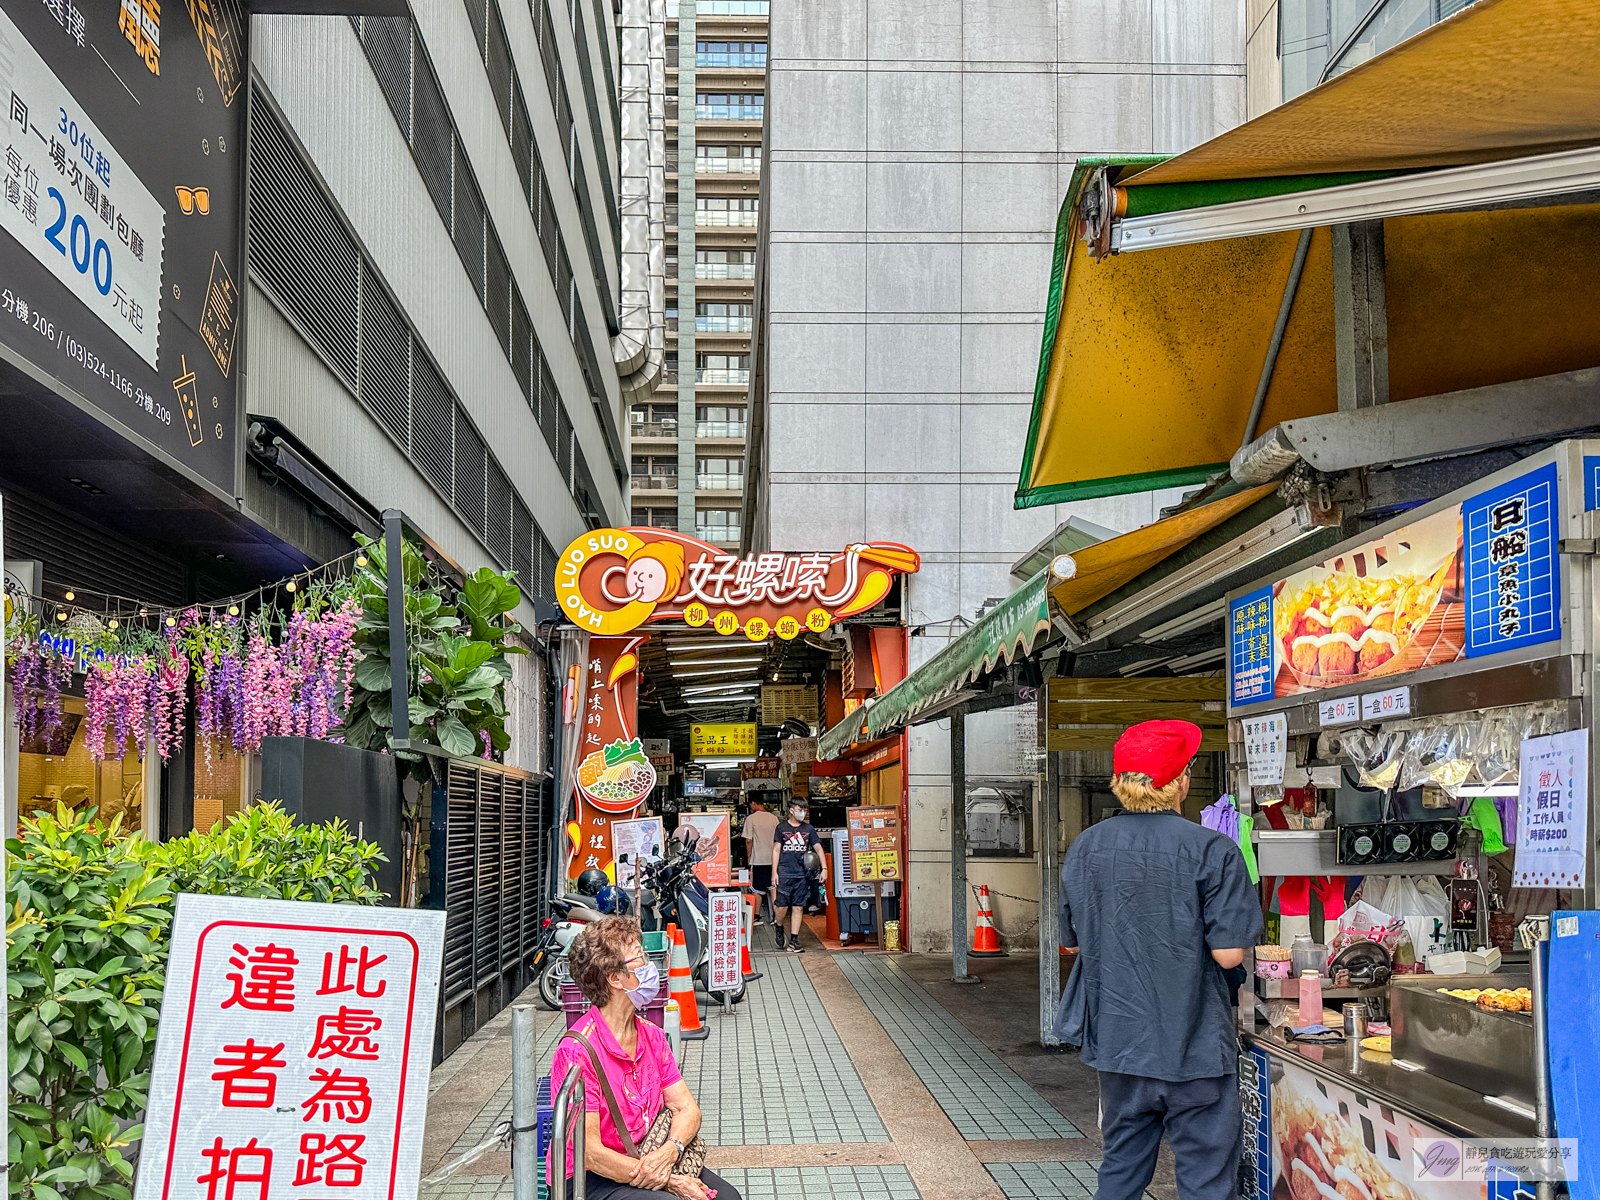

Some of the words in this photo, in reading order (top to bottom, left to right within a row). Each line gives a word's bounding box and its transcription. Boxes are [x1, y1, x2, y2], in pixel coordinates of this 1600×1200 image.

[6, 144, 39, 198] 每位
[58, 107, 110, 188] 30位起
[4, 173, 38, 226] 優惠
[10, 90, 144, 262] 同一場次團劃包廳
[1, 288, 29, 325] 分機
[32, 311, 55, 341] 206
[65, 335, 133, 398] (03)524-1166
[135, 388, 153, 415] 分機
[155, 403, 171, 426] 209
[202, 322, 218, 351] ADMIT
[217, 347, 228, 369] ONE
[561, 549, 585, 588] LUO
[587, 535, 629, 552] SUO
[676, 551, 832, 605] 好螺嗦
[566, 597, 603, 627] HAO
[689, 607, 827, 637] 柳州螺螄粉
[694, 735, 728, 745] 三品王
[1537, 790, 1560, 809] 假日
[1539, 769, 1562, 789] 徵人
[1530, 829, 1567, 841] 時薪$200
[1533, 811, 1564, 825] 工作人員
[714, 900, 724, 983] 違者拍照檢舉
[725, 899, 737, 983] 此處嚴禁停車
[197, 943, 299, 1200] 違者拍
[292, 945, 387, 1187] 此處為路
